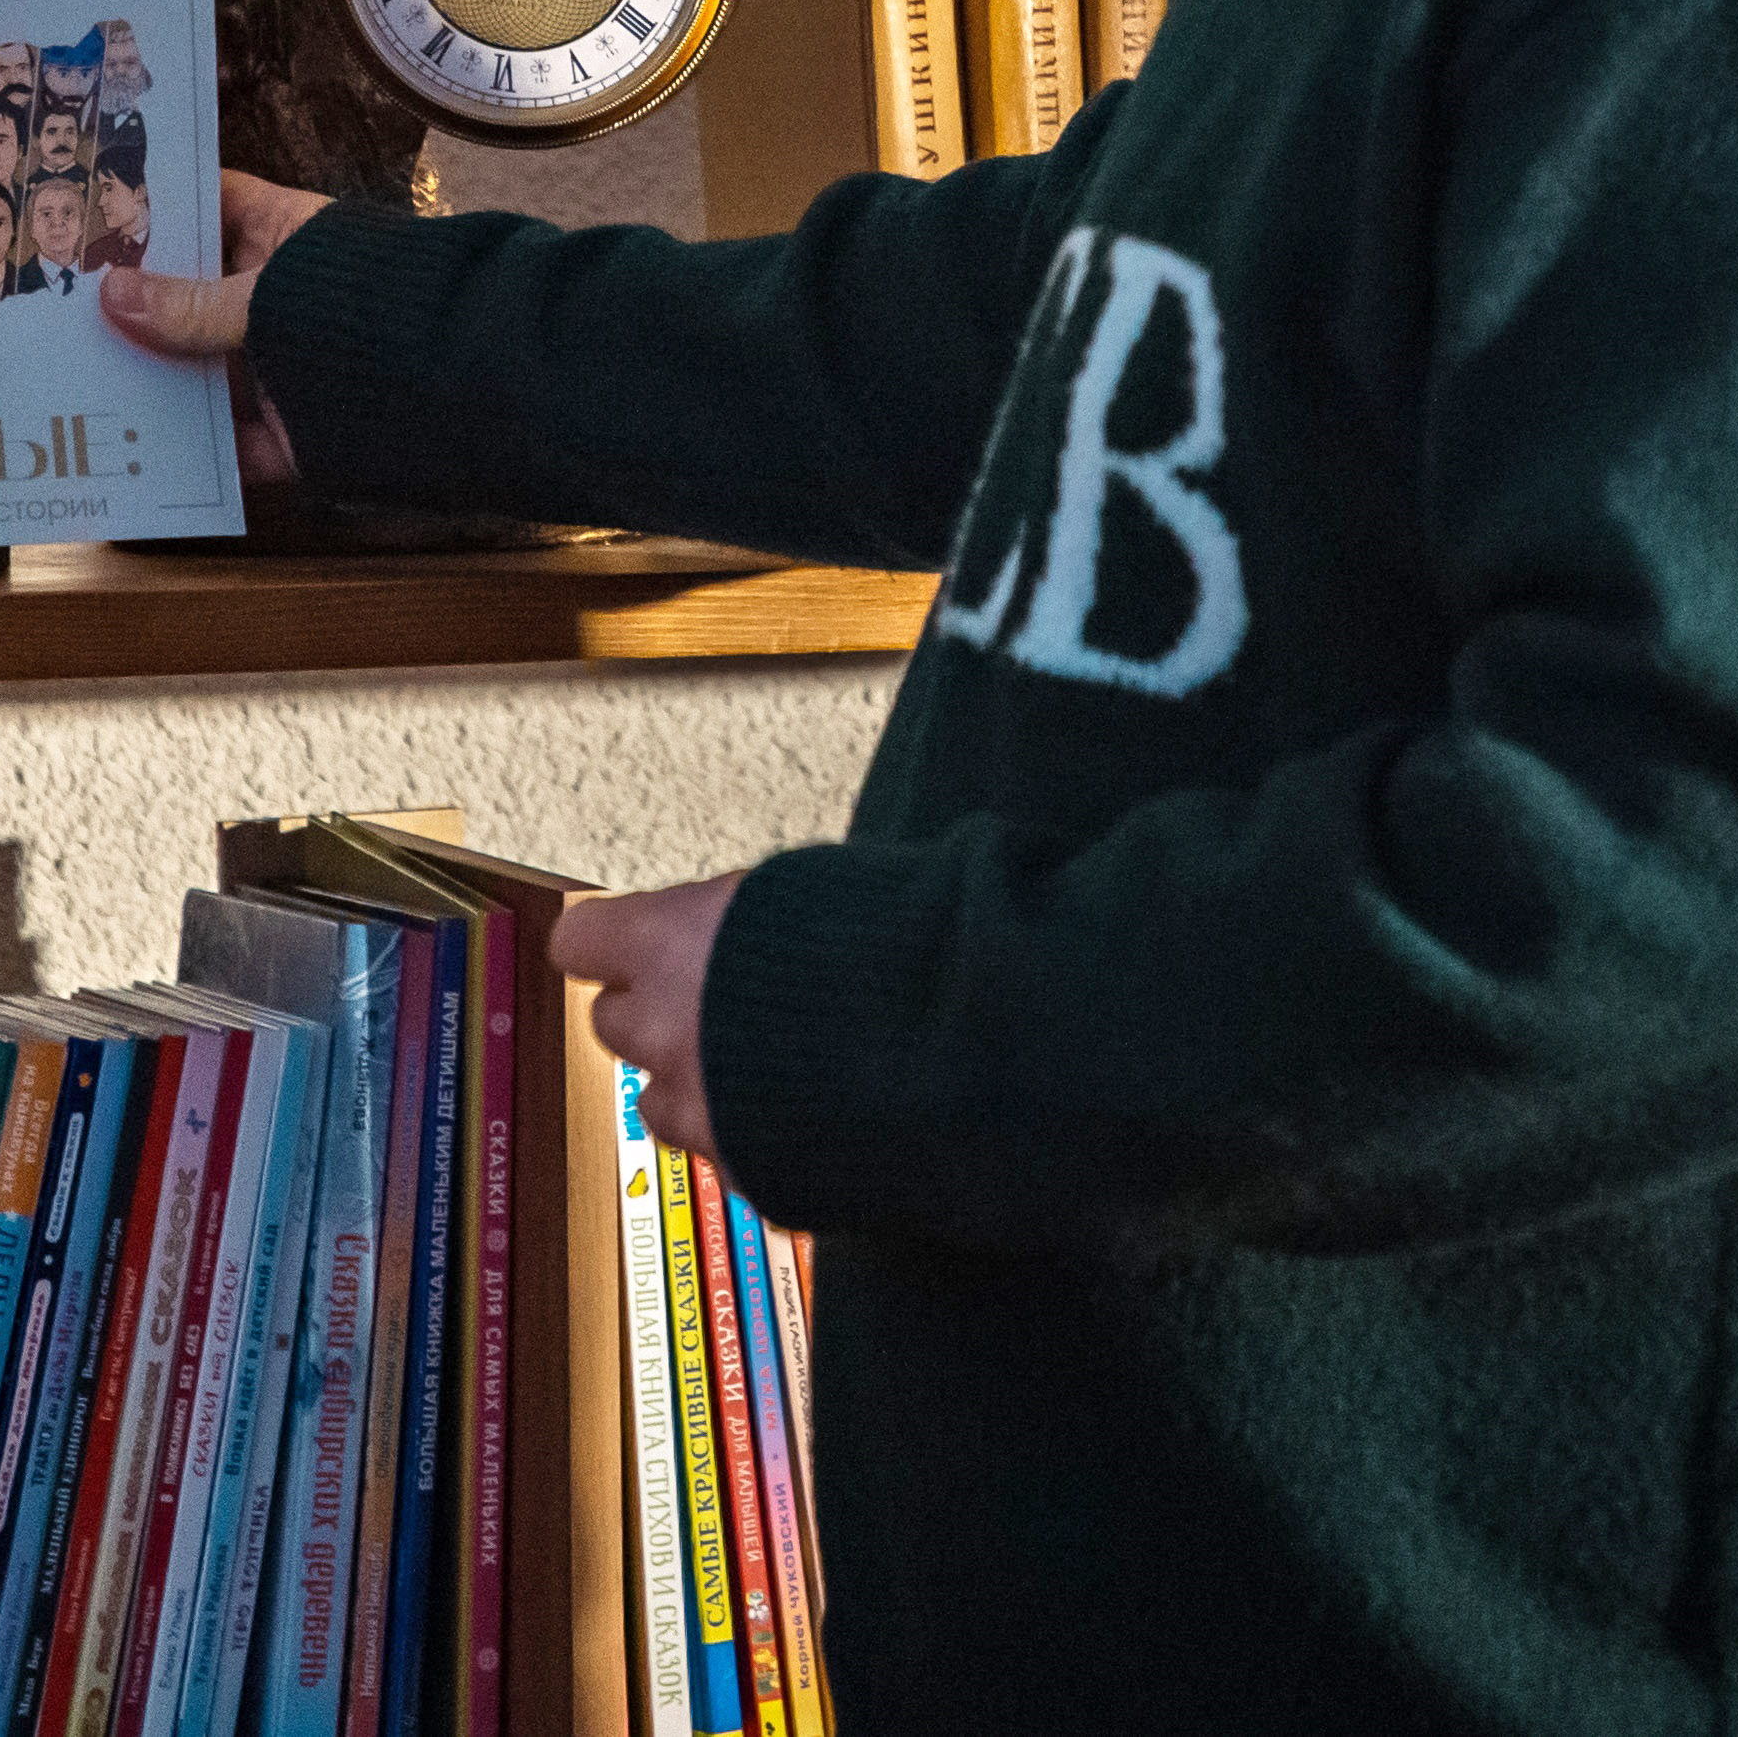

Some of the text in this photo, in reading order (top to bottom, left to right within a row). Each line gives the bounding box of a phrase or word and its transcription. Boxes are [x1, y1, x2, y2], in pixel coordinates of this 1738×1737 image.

[568, 49, 592, 85] V
[19, 1097, 48, 1165] Всегда
[20, 1063, 36, 1086] на
[141, 1165, 203, 1347] СКАЗОК
[244, 1223, 280, 1343] детский сад
[412, 987, 469, 1492] БОЛЬШАЯ КНИЖКА МАЛЕНЬКИМ ДЕТИШКАМ
[476, 1119, 508, 1565] СКАЗКИ ДЛЯ САМЫХ МАЛЕНЬКИХ
[702, 1199, 763, 1562] РУССКИЕ СКАЗКИ ДЛЯ МАЛЫШЕЙ
[759, 1364, 779, 1430] МУХА
[630, 1215, 683, 1707] БОЛЬШАЯ КНИГА СТИХОВ И СКАЗОК
[668, 1237, 732, 1628] САМЫЕ КРАСИВЫЕ СКАЗКИ
[772, 1480, 803, 1609] ЧУКОВСКИЙ
[791, 1614, 814, 1689] Корней
